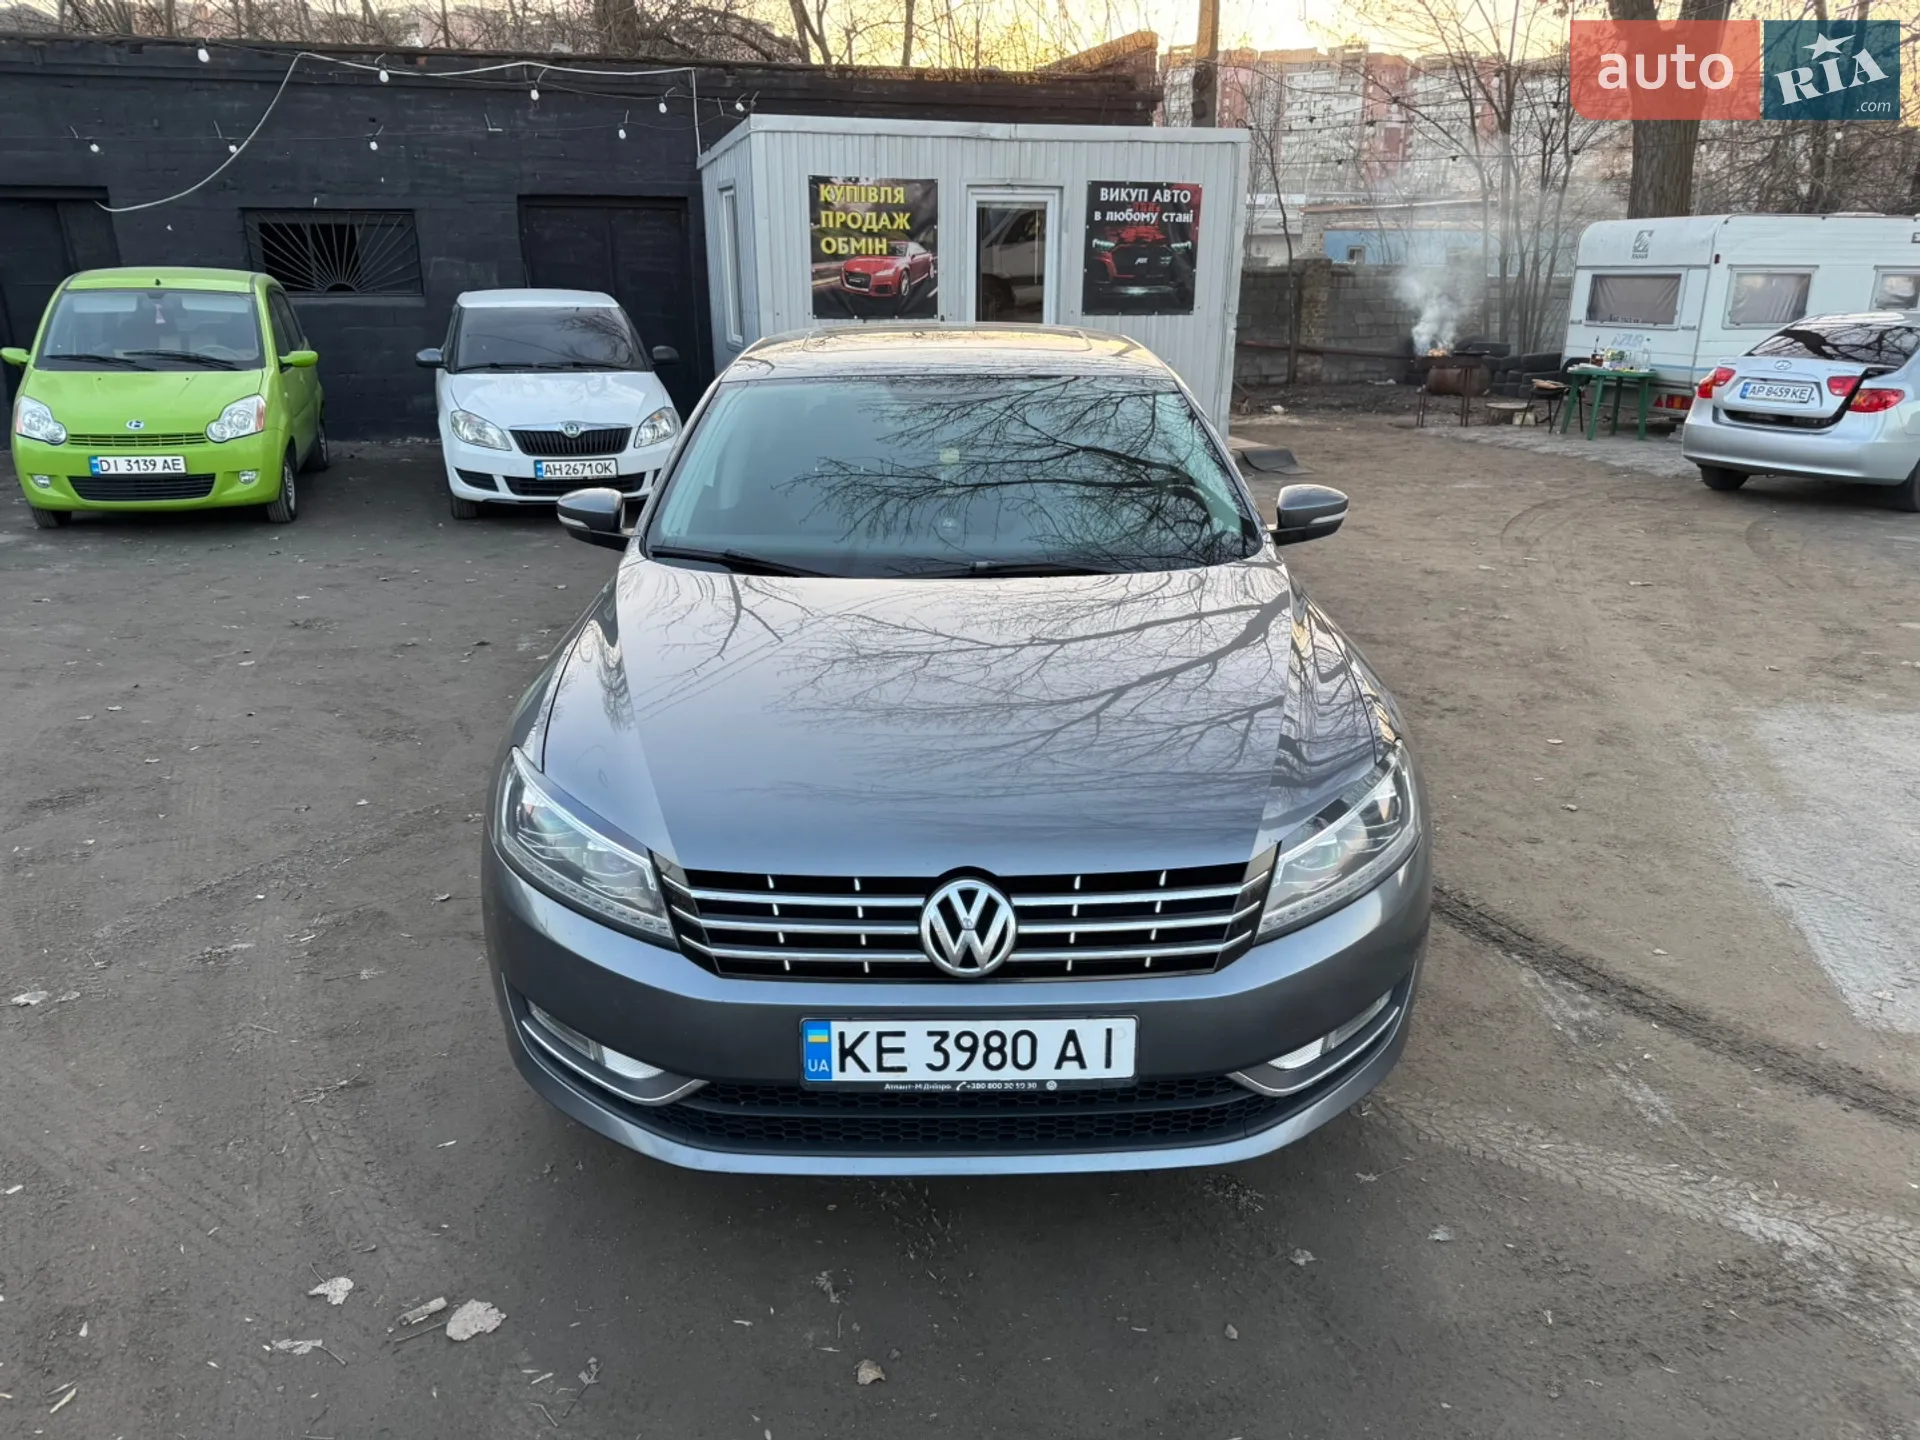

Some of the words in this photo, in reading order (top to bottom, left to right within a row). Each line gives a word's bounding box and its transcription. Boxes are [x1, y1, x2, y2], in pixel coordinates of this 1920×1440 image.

[820, 184, 905, 204] КУПІВЛЯ
[1100, 187, 1148, 202] ВИКУП
[1152, 189, 1191, 203] АВТО
[821, 211, 911, 233] ПРОДАЖ
[1094, 211, 1102, 221] в
[1105, 208, 1159, 224] любому
[1162, 209, 1194, 223] стані
[821, 237, 888, 255] ОБМІН
[124, 459, 157, 472] 3139
[162, 459, 182, 471] AE
[838, 1030, 908, 1073] KE
[925, 1029, 1038, 1072] 3980
[808, 1060, 830, 1072] UA
